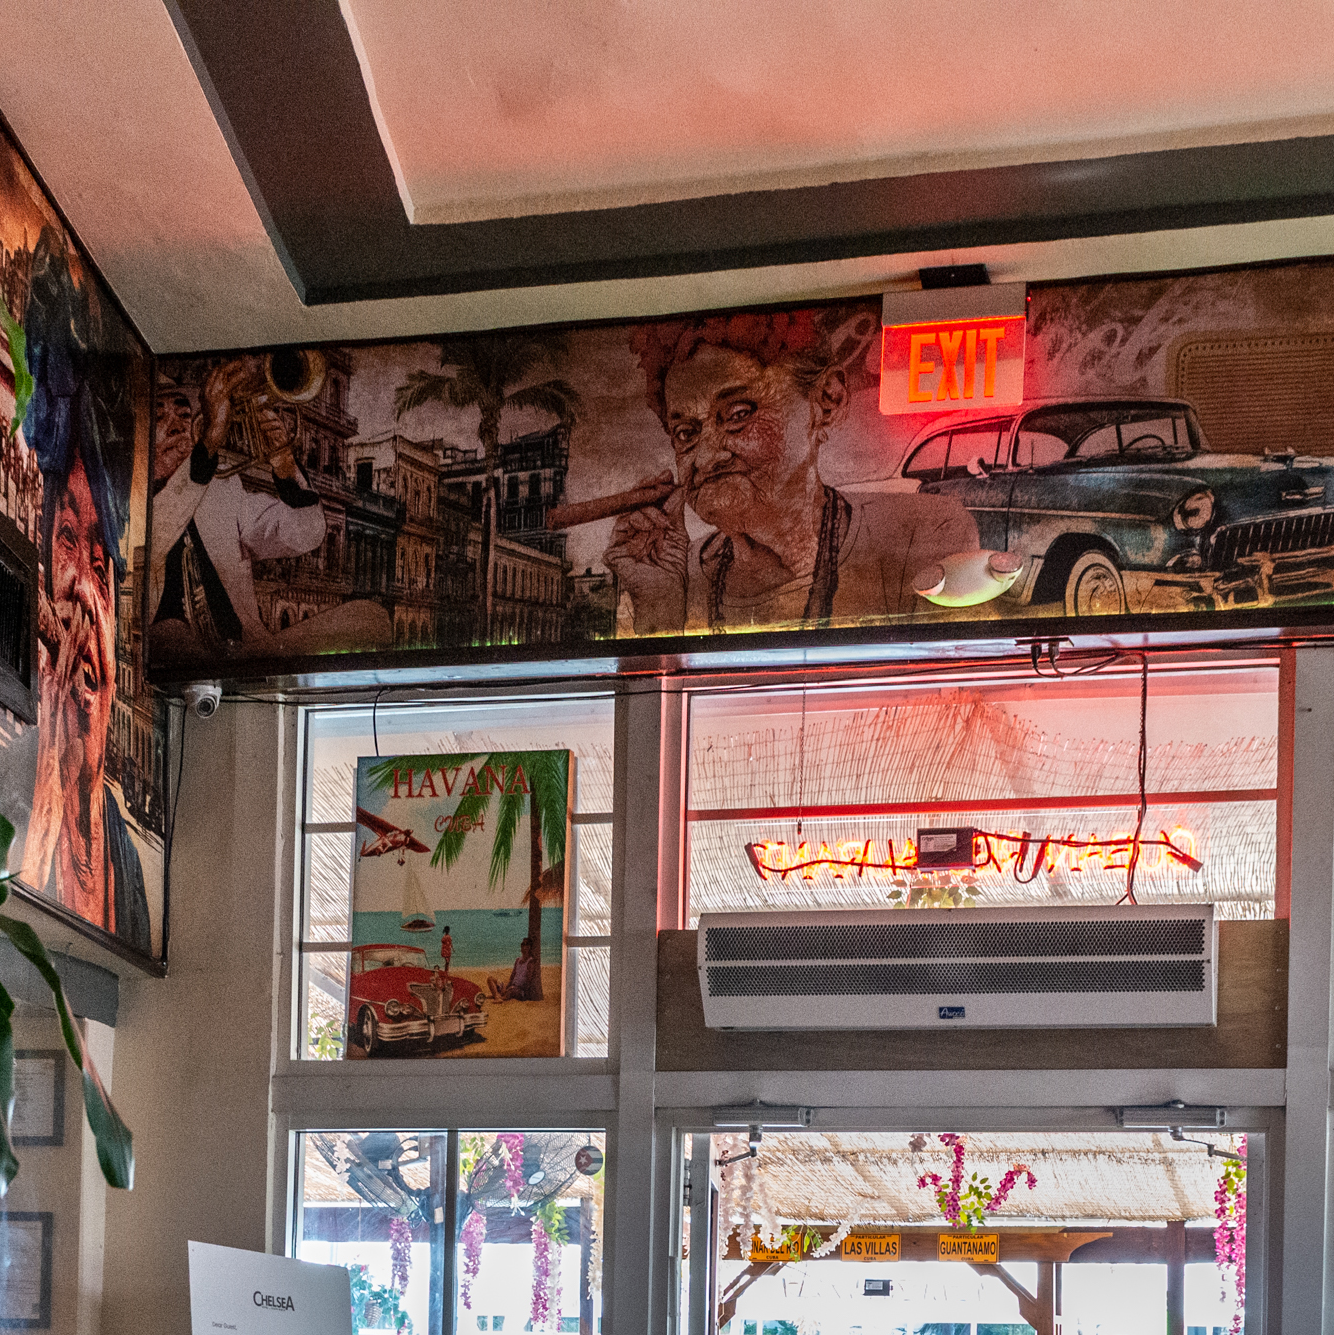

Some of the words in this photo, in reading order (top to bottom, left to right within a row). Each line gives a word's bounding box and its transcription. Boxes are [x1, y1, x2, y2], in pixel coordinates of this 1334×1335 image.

[908, 327, 1005, 403] EXIT
[391, 764, 531, 799] HAVANA
[434, 813, 486, 833] CUBA
[844, 1241, 864, 1255] LAS
[866, 1241, 898, 1256] VILLAS
[940, 1241, 996, 1256] GUANTANAMO
[254, 1291, 295, 1311] CHELSEA
